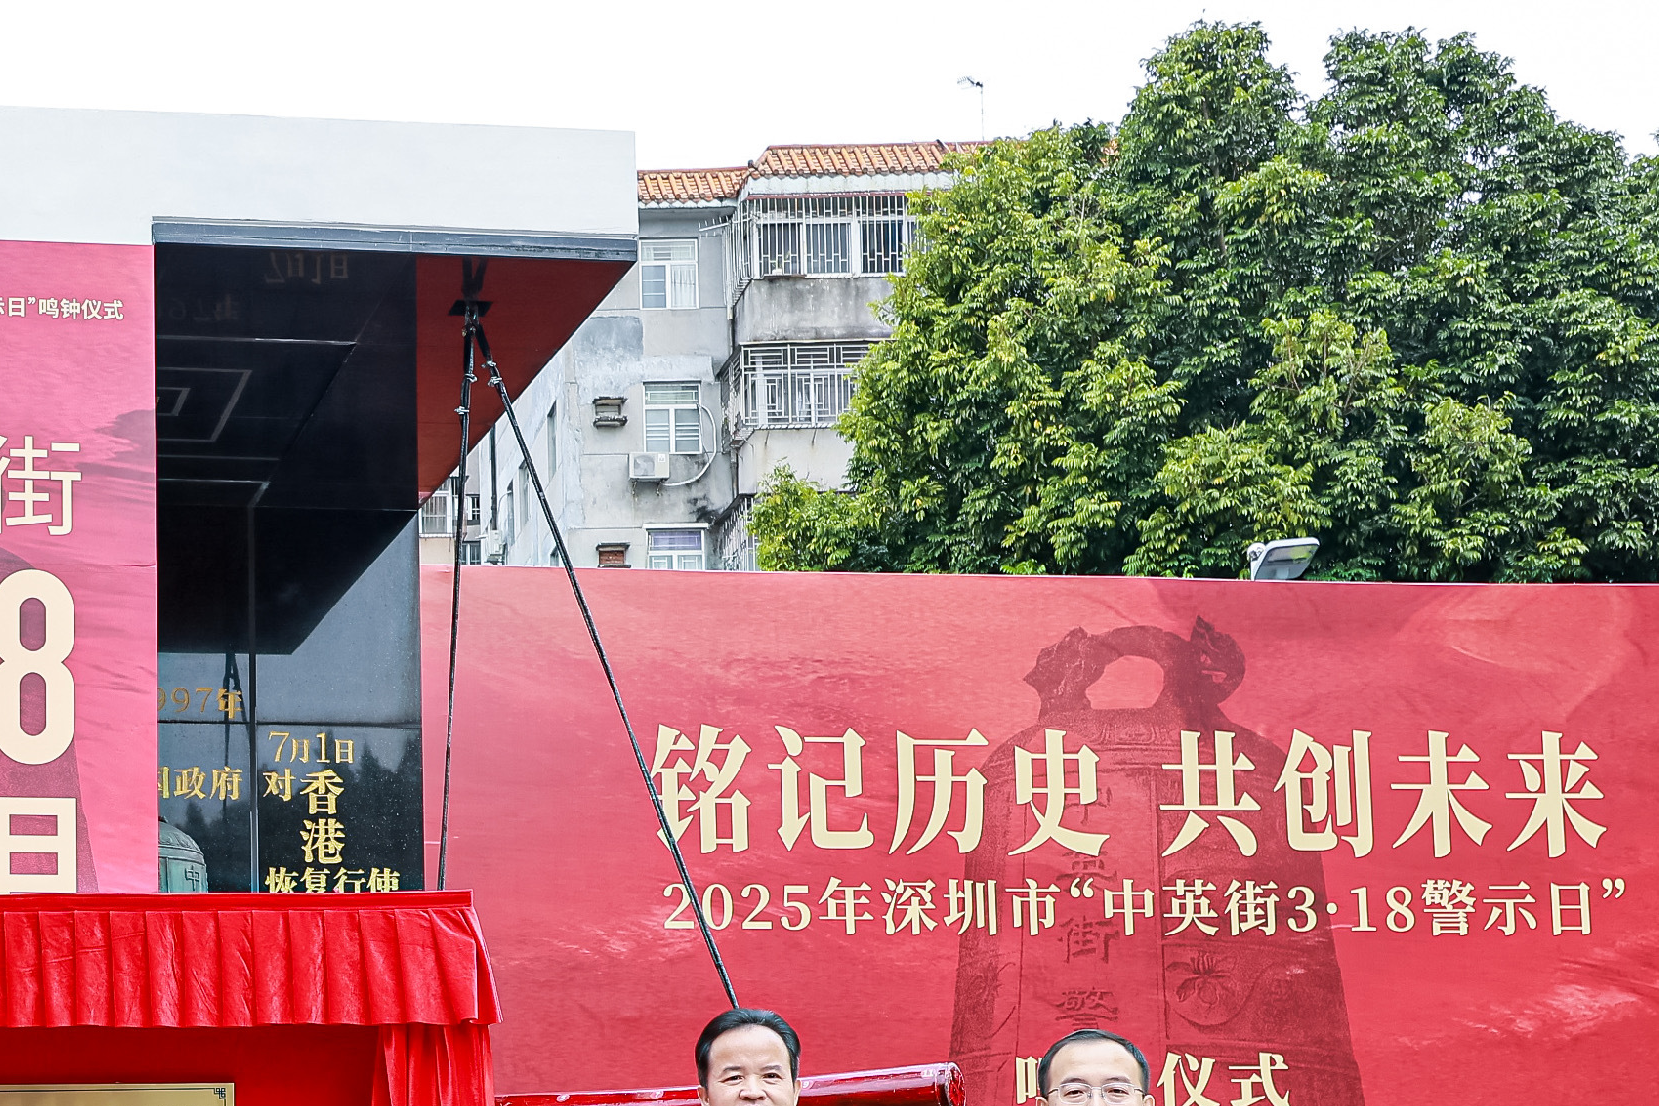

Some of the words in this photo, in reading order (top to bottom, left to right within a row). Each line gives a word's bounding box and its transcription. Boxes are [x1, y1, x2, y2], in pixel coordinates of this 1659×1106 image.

[268, 731, 355, 764] 7月1日
[651, 723, 1113, 858] 铭记历史
[1158, 728, 1608, 859] 共创未来
[662, 876, 1627, 938] 2025年深圳市“中英街3·18警示日”
